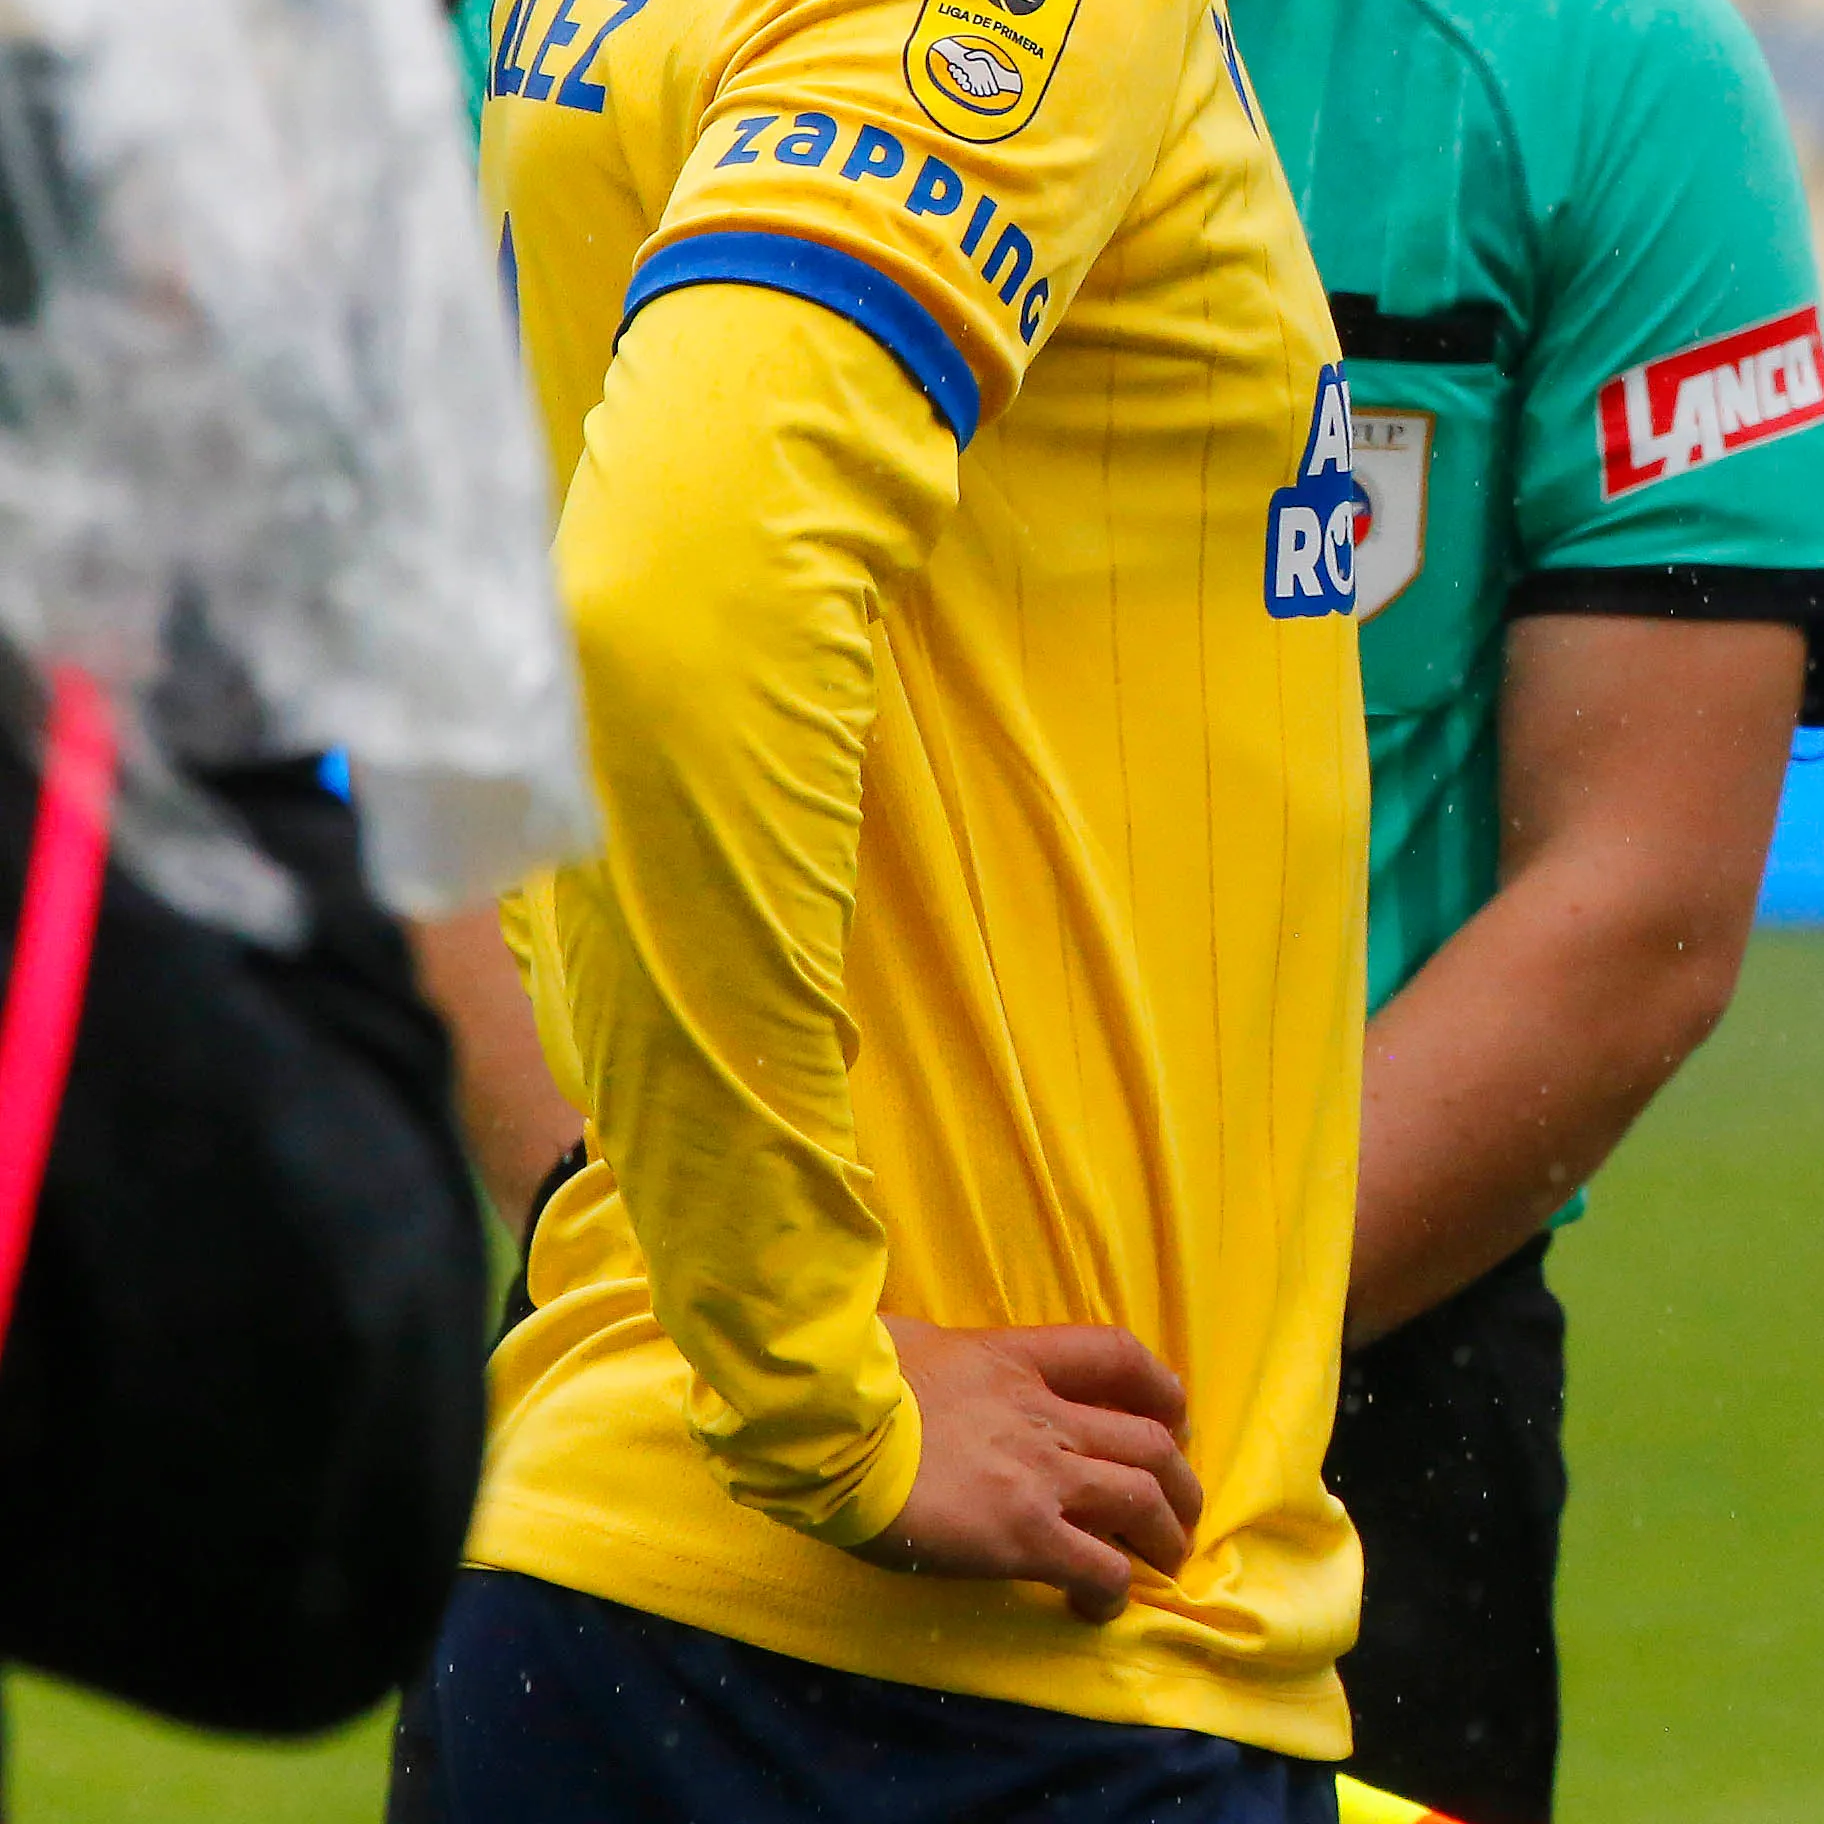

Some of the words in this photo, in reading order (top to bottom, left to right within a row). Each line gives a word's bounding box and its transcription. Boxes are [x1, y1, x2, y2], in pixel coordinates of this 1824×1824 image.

[938, 2, 969, 23] LIGA
[973, 14, 992, 29] DE
[992, 21, 1045, 60] PRIMERA
[1625, 334, 1824, 474] LANCO
